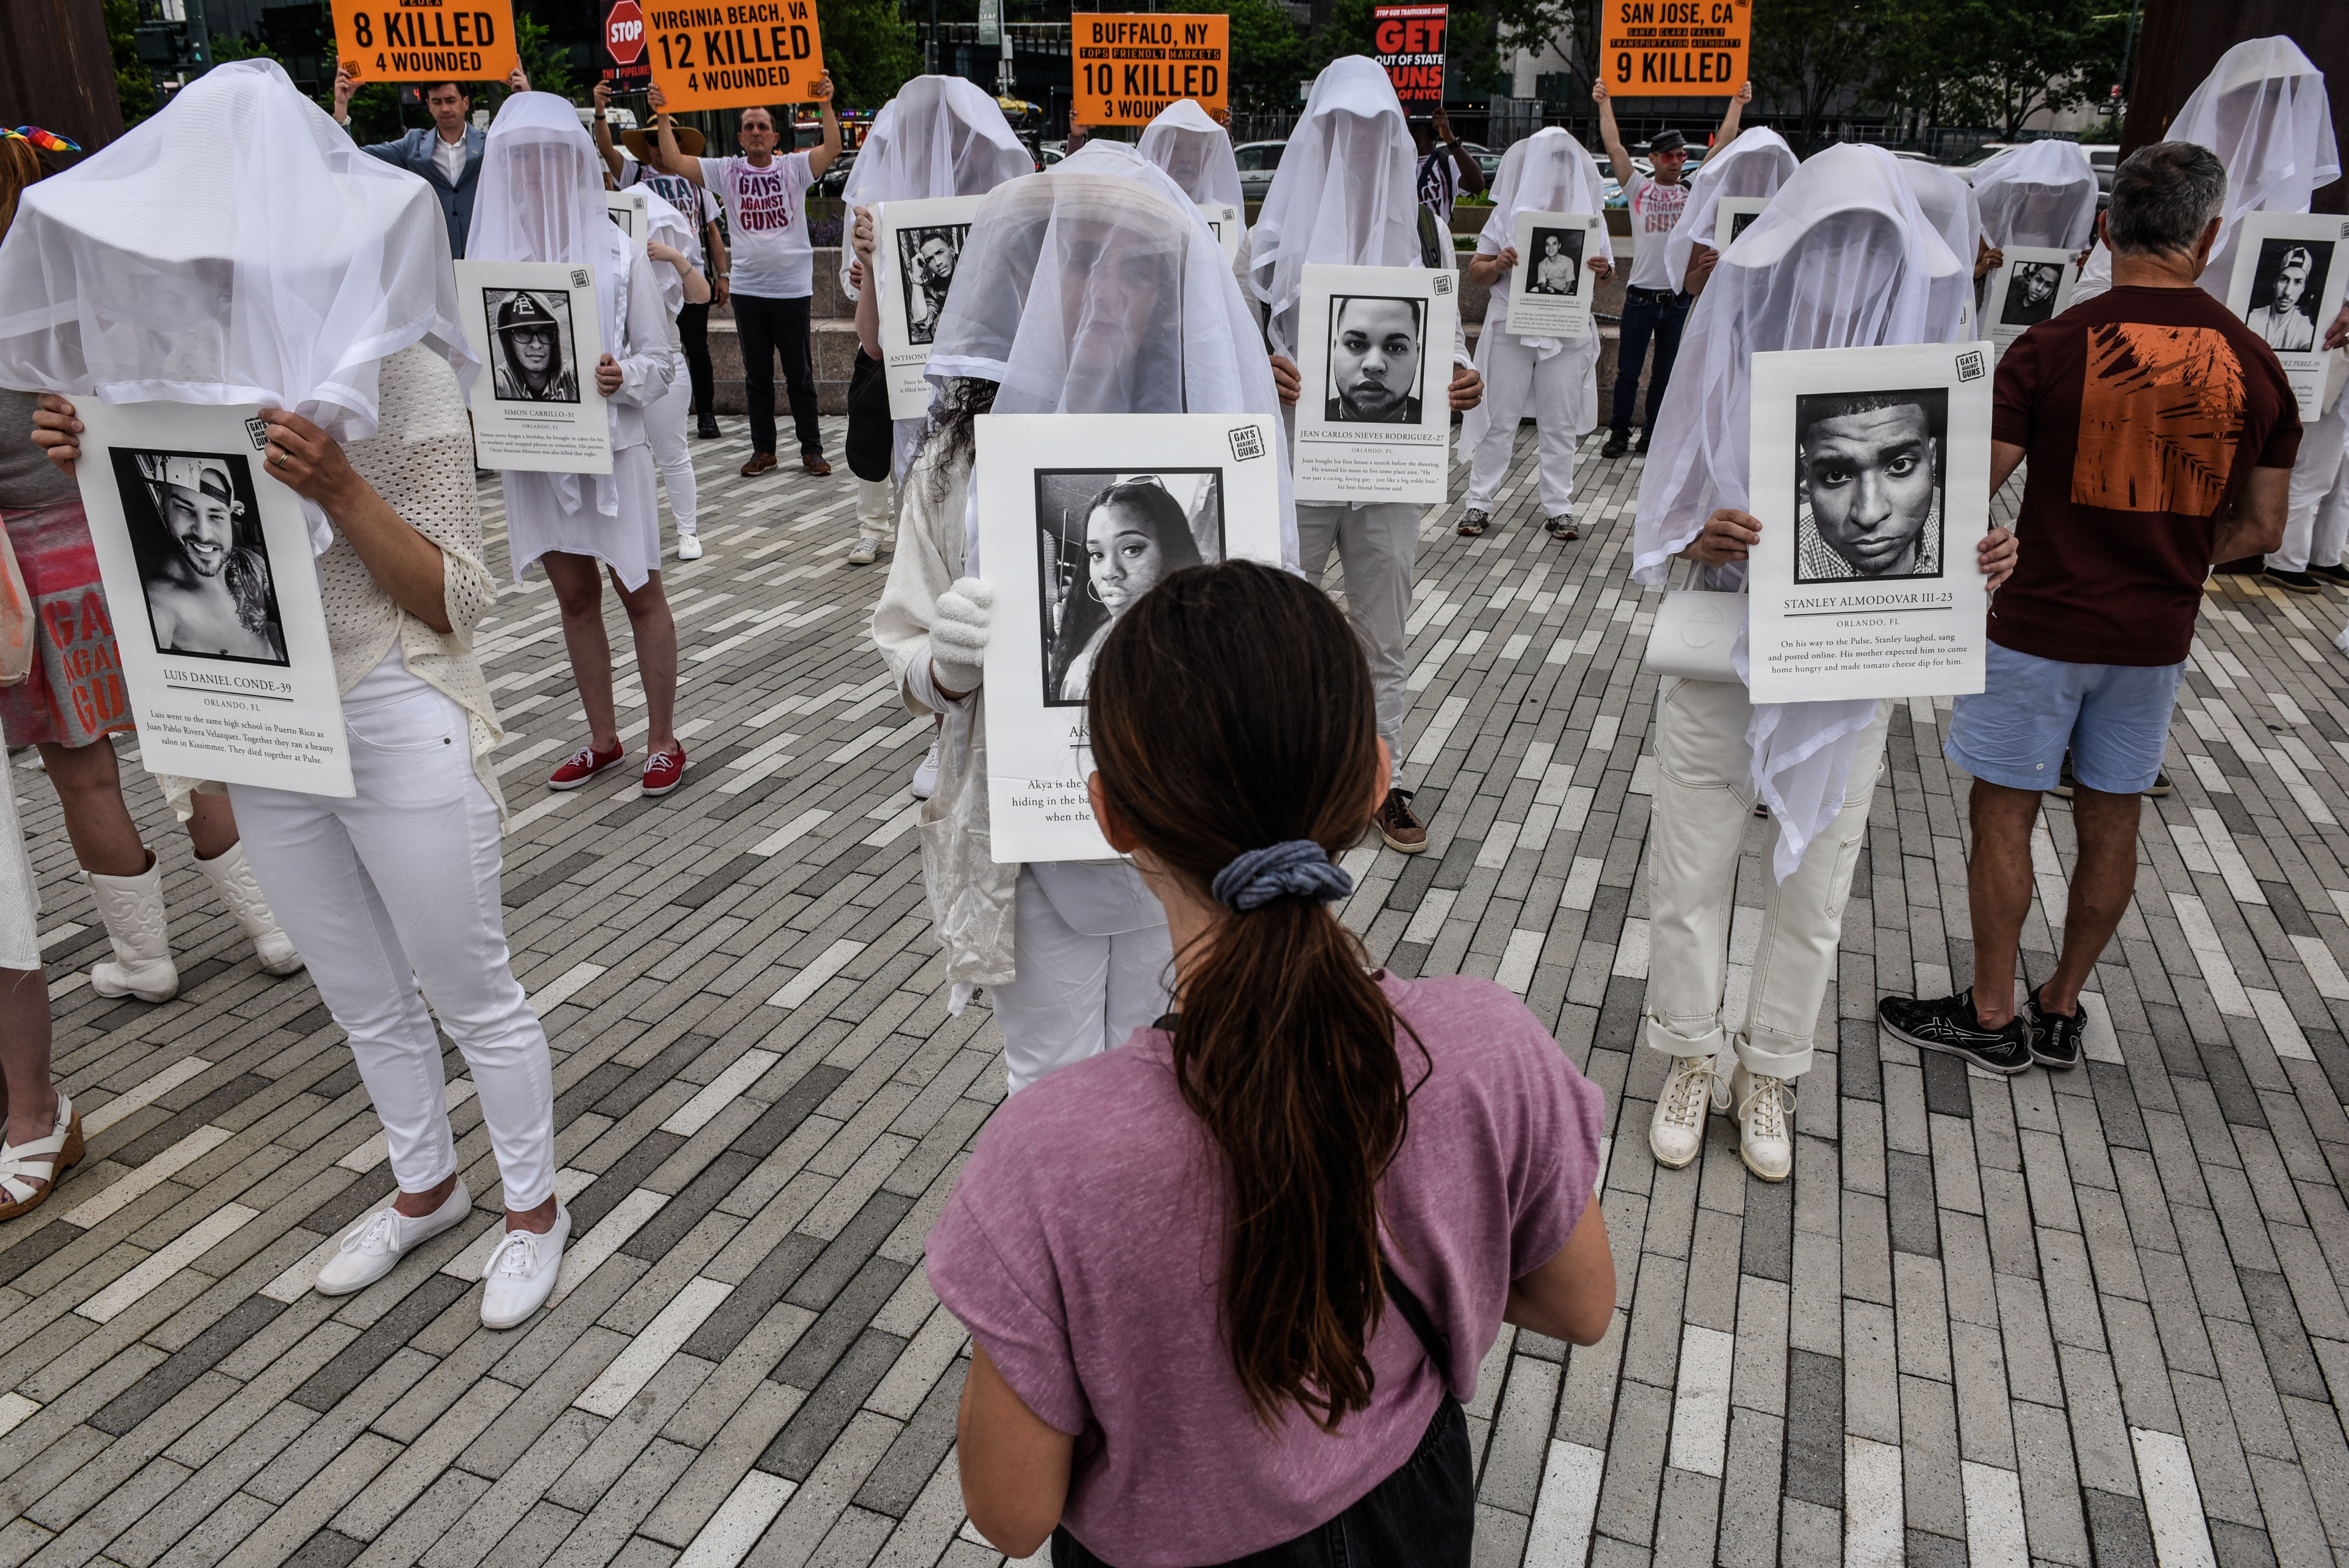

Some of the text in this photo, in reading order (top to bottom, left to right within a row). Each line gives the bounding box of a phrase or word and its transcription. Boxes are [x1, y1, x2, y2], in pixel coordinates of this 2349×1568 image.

[651, 1, 808, 30] VIRGINIA BEACH, VA
[1621, 4, 1733, 26] SAN JOSE, CA
[354, 12, 494, 48] 8 KILLED
[611, 20, 642, 43] STOP
[1093, 22, 1208, 48] BUFFALO, NY
[1376, 19, 1445, 53] GET
[1628, 28, 1725, 36] SANTA CLARA VALLEY
[658, 25, 810, 69] 12 KILLED
[1611, 39, 1740, 48] TRANSPORTATION AUTHORITY
[1081, 48, 1220, 59] TOPS FRIENDLY MARKETS
[1375, 54, 1443, 65] OUT OF STATE
[376, 52, 386, 72] 4
[392, 52, 482, 72] WOUNDED
[1617, 52, 1731, 83] 9 KILLED
[603, 69, 615, 79] THE
[688, 73, 698, 92] 4
[702, 66, 790, 91] WOUNDED
[1083, 63, 1218, 97] 10 KILLED
[1398, 89, 1441, 100] OF NYC!
[1105, 100, 1173, 118] 3 WOUN
[739, 174, 782, 197] GAYS
[741, 194, 784, 211] AGAINST
[1647, 200, 1687, 212] AGAINS
[740, 207, 789, 231] GUNS
[890, 353, 927, 362] ANTHONY
[1960, 355, 1978, 365] GAYS
[1962, 362, 1978, 371] AGAINST
[1963, 368, 1980, 378] GUNS
[250, 421, 267, 432] GAYS
[256, 436, 269, 446] GUN
[1234, 429, 1256, 442] GAYS
[1300, 430, 1320, 438] JEAN
[1385, 433, 1444, 441] RODRIGUEZ-27
[1237, 439, 1256, 448] AGAINST
[1238, 445, 1259, 457] GUNS
[1784, 592, 1953, 609] STANLEY ALMODOVAR III-23
[1836, 618, 1886, 627] ORLANDO,
[1836, 637, 1848, 645] the
[1875, 635, 1902, 644] Stanley
[1904, 634, 1936, 644] laughed,
[1768, 653, 1782, 661] and
[1784, 651, 1809, 662] posted
[1811, 651, 1837, 659] online.
[1856, 648, 1883, 657] mother
[1885, 647, 1917, 657] expected
[163, 669, 291, 693] LUIS DANIEL CONDE-39
[204, 698, 248, 711] ORLANDO,
[150, 709, 165, 718] Luis
[193, 714, 204, 723] the
[223, 718, 240, 729] high
[241, 721, 263, 730] school
[273, 724, 297, 735] Puerto
[298, 727, 315, 736] Rico
[146, 722, 161, 731] Juan
[163, 724, 181, 733] Pablo
[183, 726, 205, 736] Rivera
[205, 729, 241, 741] Velazquez.
[241, 733, 272, 745] Together
[274, 737, 289, 749] they
[309, 741, 334, 754] beauty
[1028, 780, 1052, 791] Akya
[1056, 780, 1062, 788] is
[1066, 779, 1081, 788] the
[1012, 797, 1044, 808] hiding
[1061, 795, 1075, 804] the
[1046, 812, 1090, 821] when the
